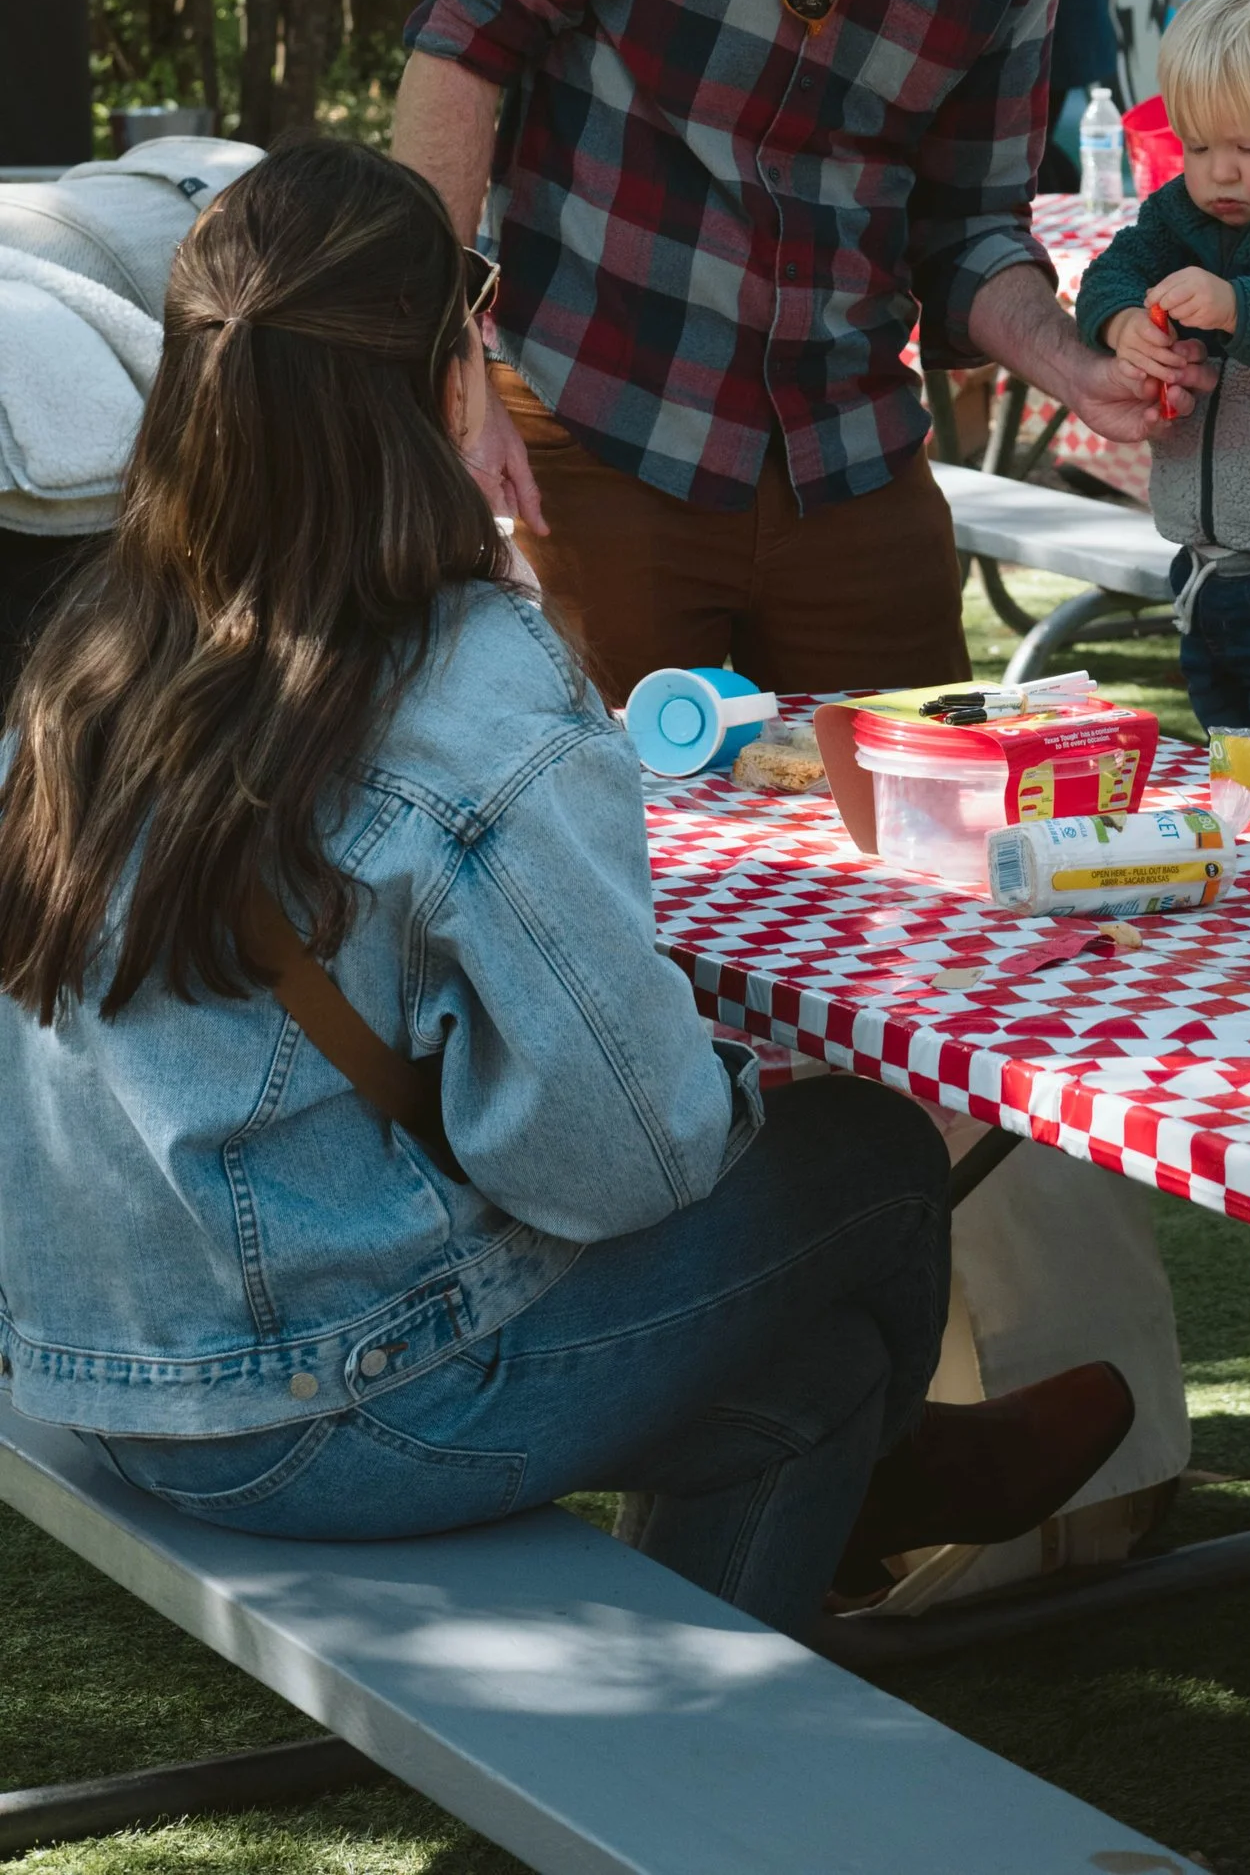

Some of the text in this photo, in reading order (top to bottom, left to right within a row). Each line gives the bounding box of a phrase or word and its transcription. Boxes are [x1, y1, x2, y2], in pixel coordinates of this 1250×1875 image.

[1044, 736, 1060, 745] Texas
[1095, 726, 1120, 736] container
[1062, 741, 1070, 749] fit
[1070, 739, 1087, 748] every
[1199, 815, 1217, 831] 80
[1091, 869, 1109, 879] OPEN
[1110, 868, 1127, 877] HERE
[1132, 867, 1148, 876] PULL
[1149, 866, 1161, 875] OUT
[1162, 865, 1180, 874] BAGS
[1101, 877, 1119, 886] ABRIR
[1124, 875, 1145, 885] SACAR
[1146, 874, 1170, 884] BOLSAS
